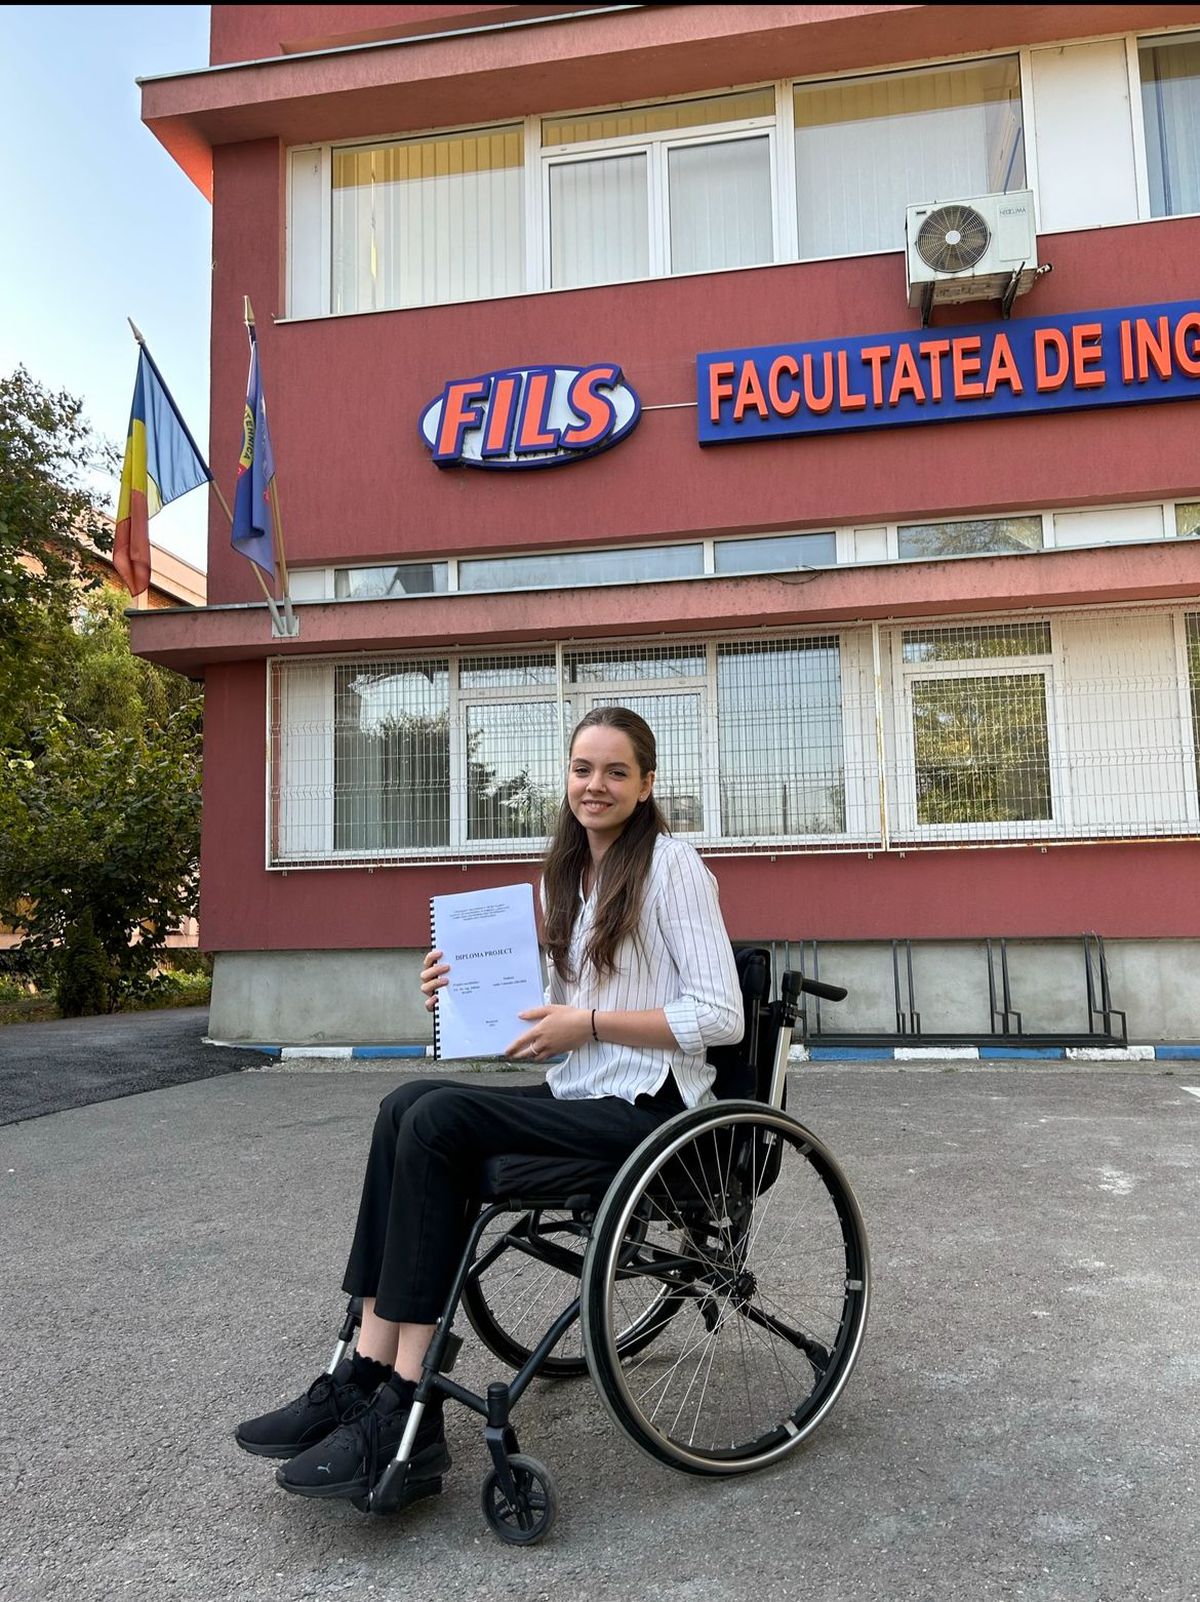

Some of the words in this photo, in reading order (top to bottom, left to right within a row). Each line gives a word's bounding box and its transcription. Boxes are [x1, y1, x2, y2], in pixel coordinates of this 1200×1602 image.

[708, 332, 1024, 424] FACULTATEA
[1033, 322, 1106, 392] DE
[1119, 311, 1200, 386] ING
[243, 409, 255, 460] TEHNICA
[436, 366, 617, 460] FILS
[455, 951, 484, 961] DIPLOMA
[484, 947, 513, 958] PROJECT
